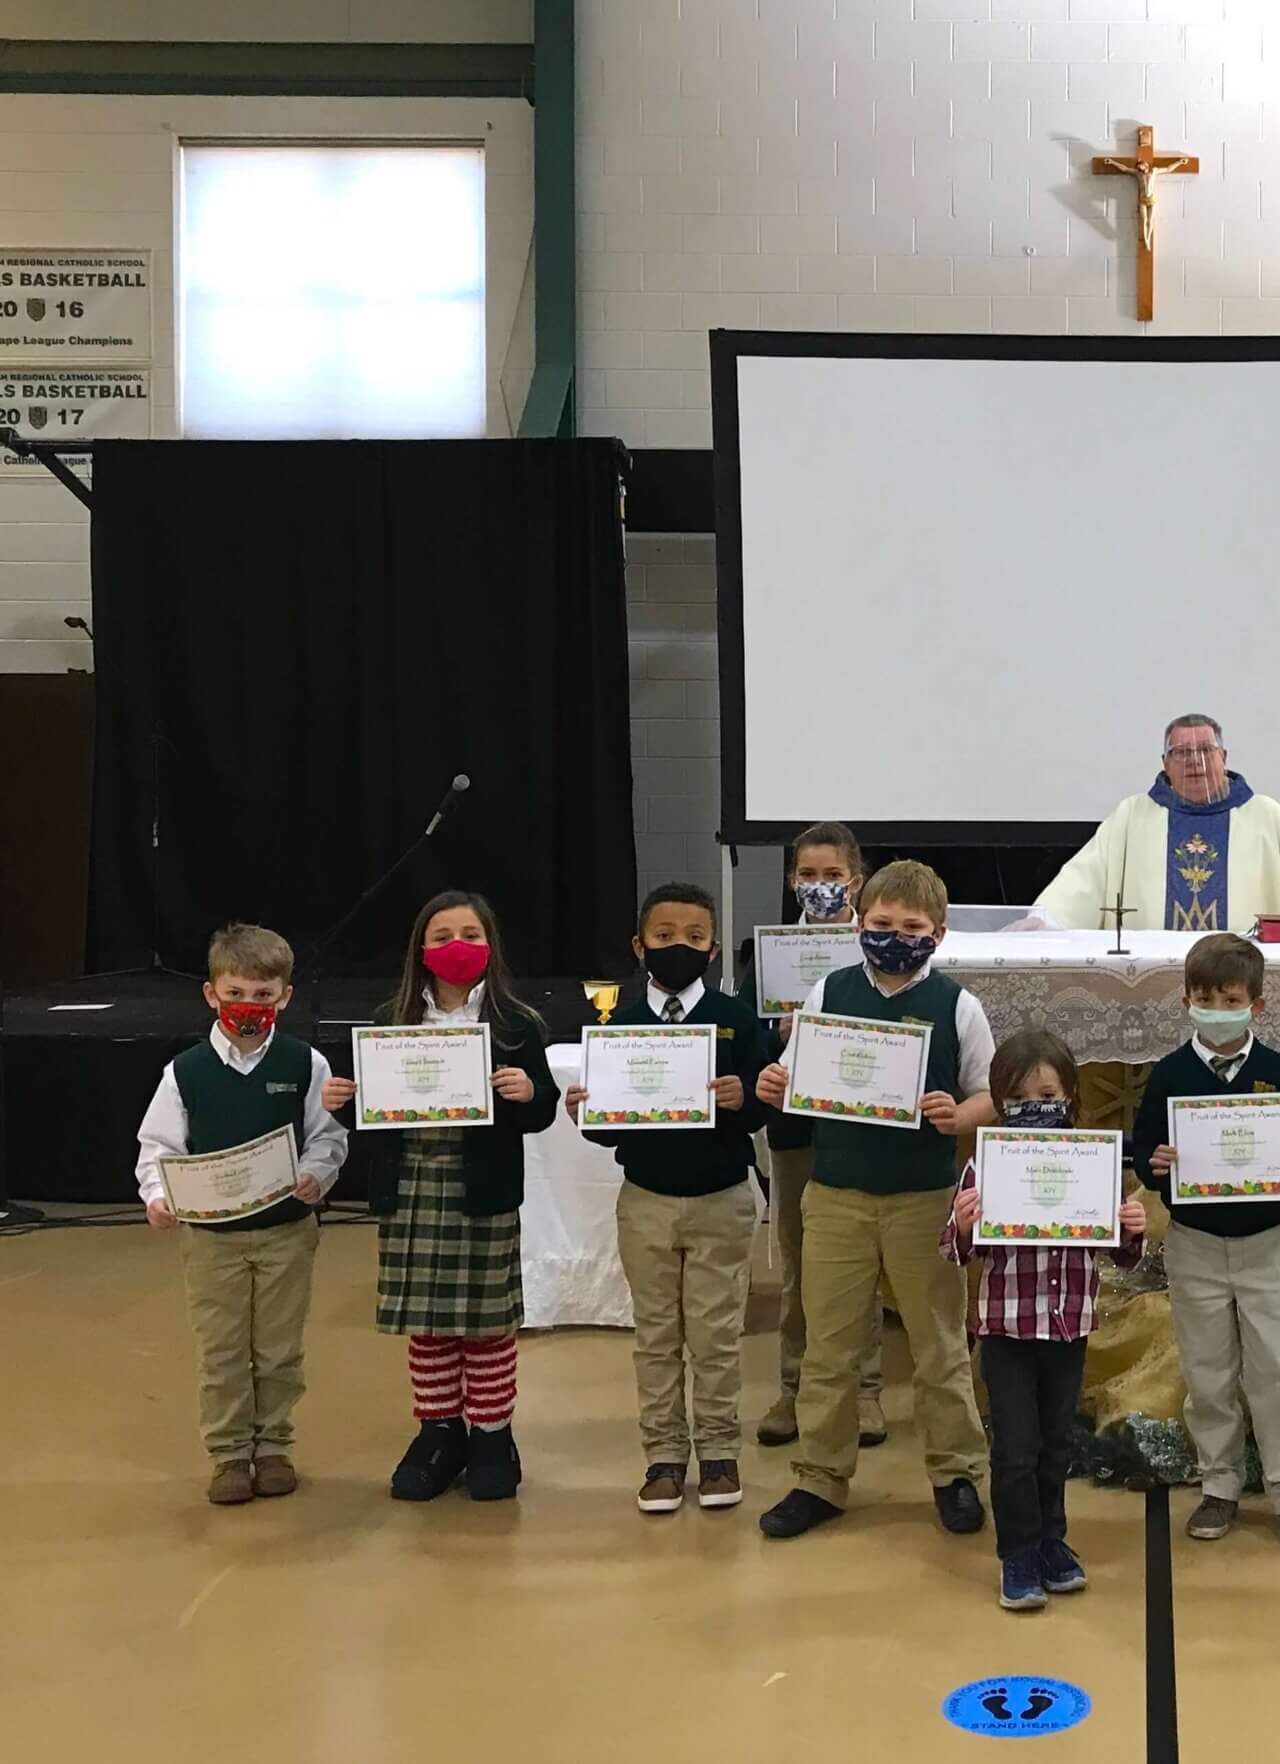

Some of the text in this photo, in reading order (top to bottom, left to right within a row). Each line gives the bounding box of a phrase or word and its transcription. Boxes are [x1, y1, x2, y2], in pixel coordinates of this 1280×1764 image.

[20, 273, 145, 287] BASKETBALL
[0, 301, 84, 318] 0 16
[0, 336, 132, 346] ape League Champions
[23, 385, 146, 398] BASKETBALL
[58, 409, 84, 424] 17
[442, 1040, 467, 1048] Award
[603, 1041, 620, 1049] Fruit
[632, 1040, 642, 1048] the
[644, 1040, 665, 1050] Spirit
[668, 1040, 692, 1049] Award
[844, 1032, 854, 1040] the
[880, 1037, 905, 1047] Award
[1191, 1112, 1208, 1122] Fruit
[1220, 1111, 1231, 1119] the
[1233, 1111, 1255, 1122] Spirit
[1001, 1145, 1020, 1156] Fruit
[1032, 1146, 1043, 1154] the
[1046, 1147, 1069, 1158] Spirit
[1071, 1147, 1097, 1157] Award
